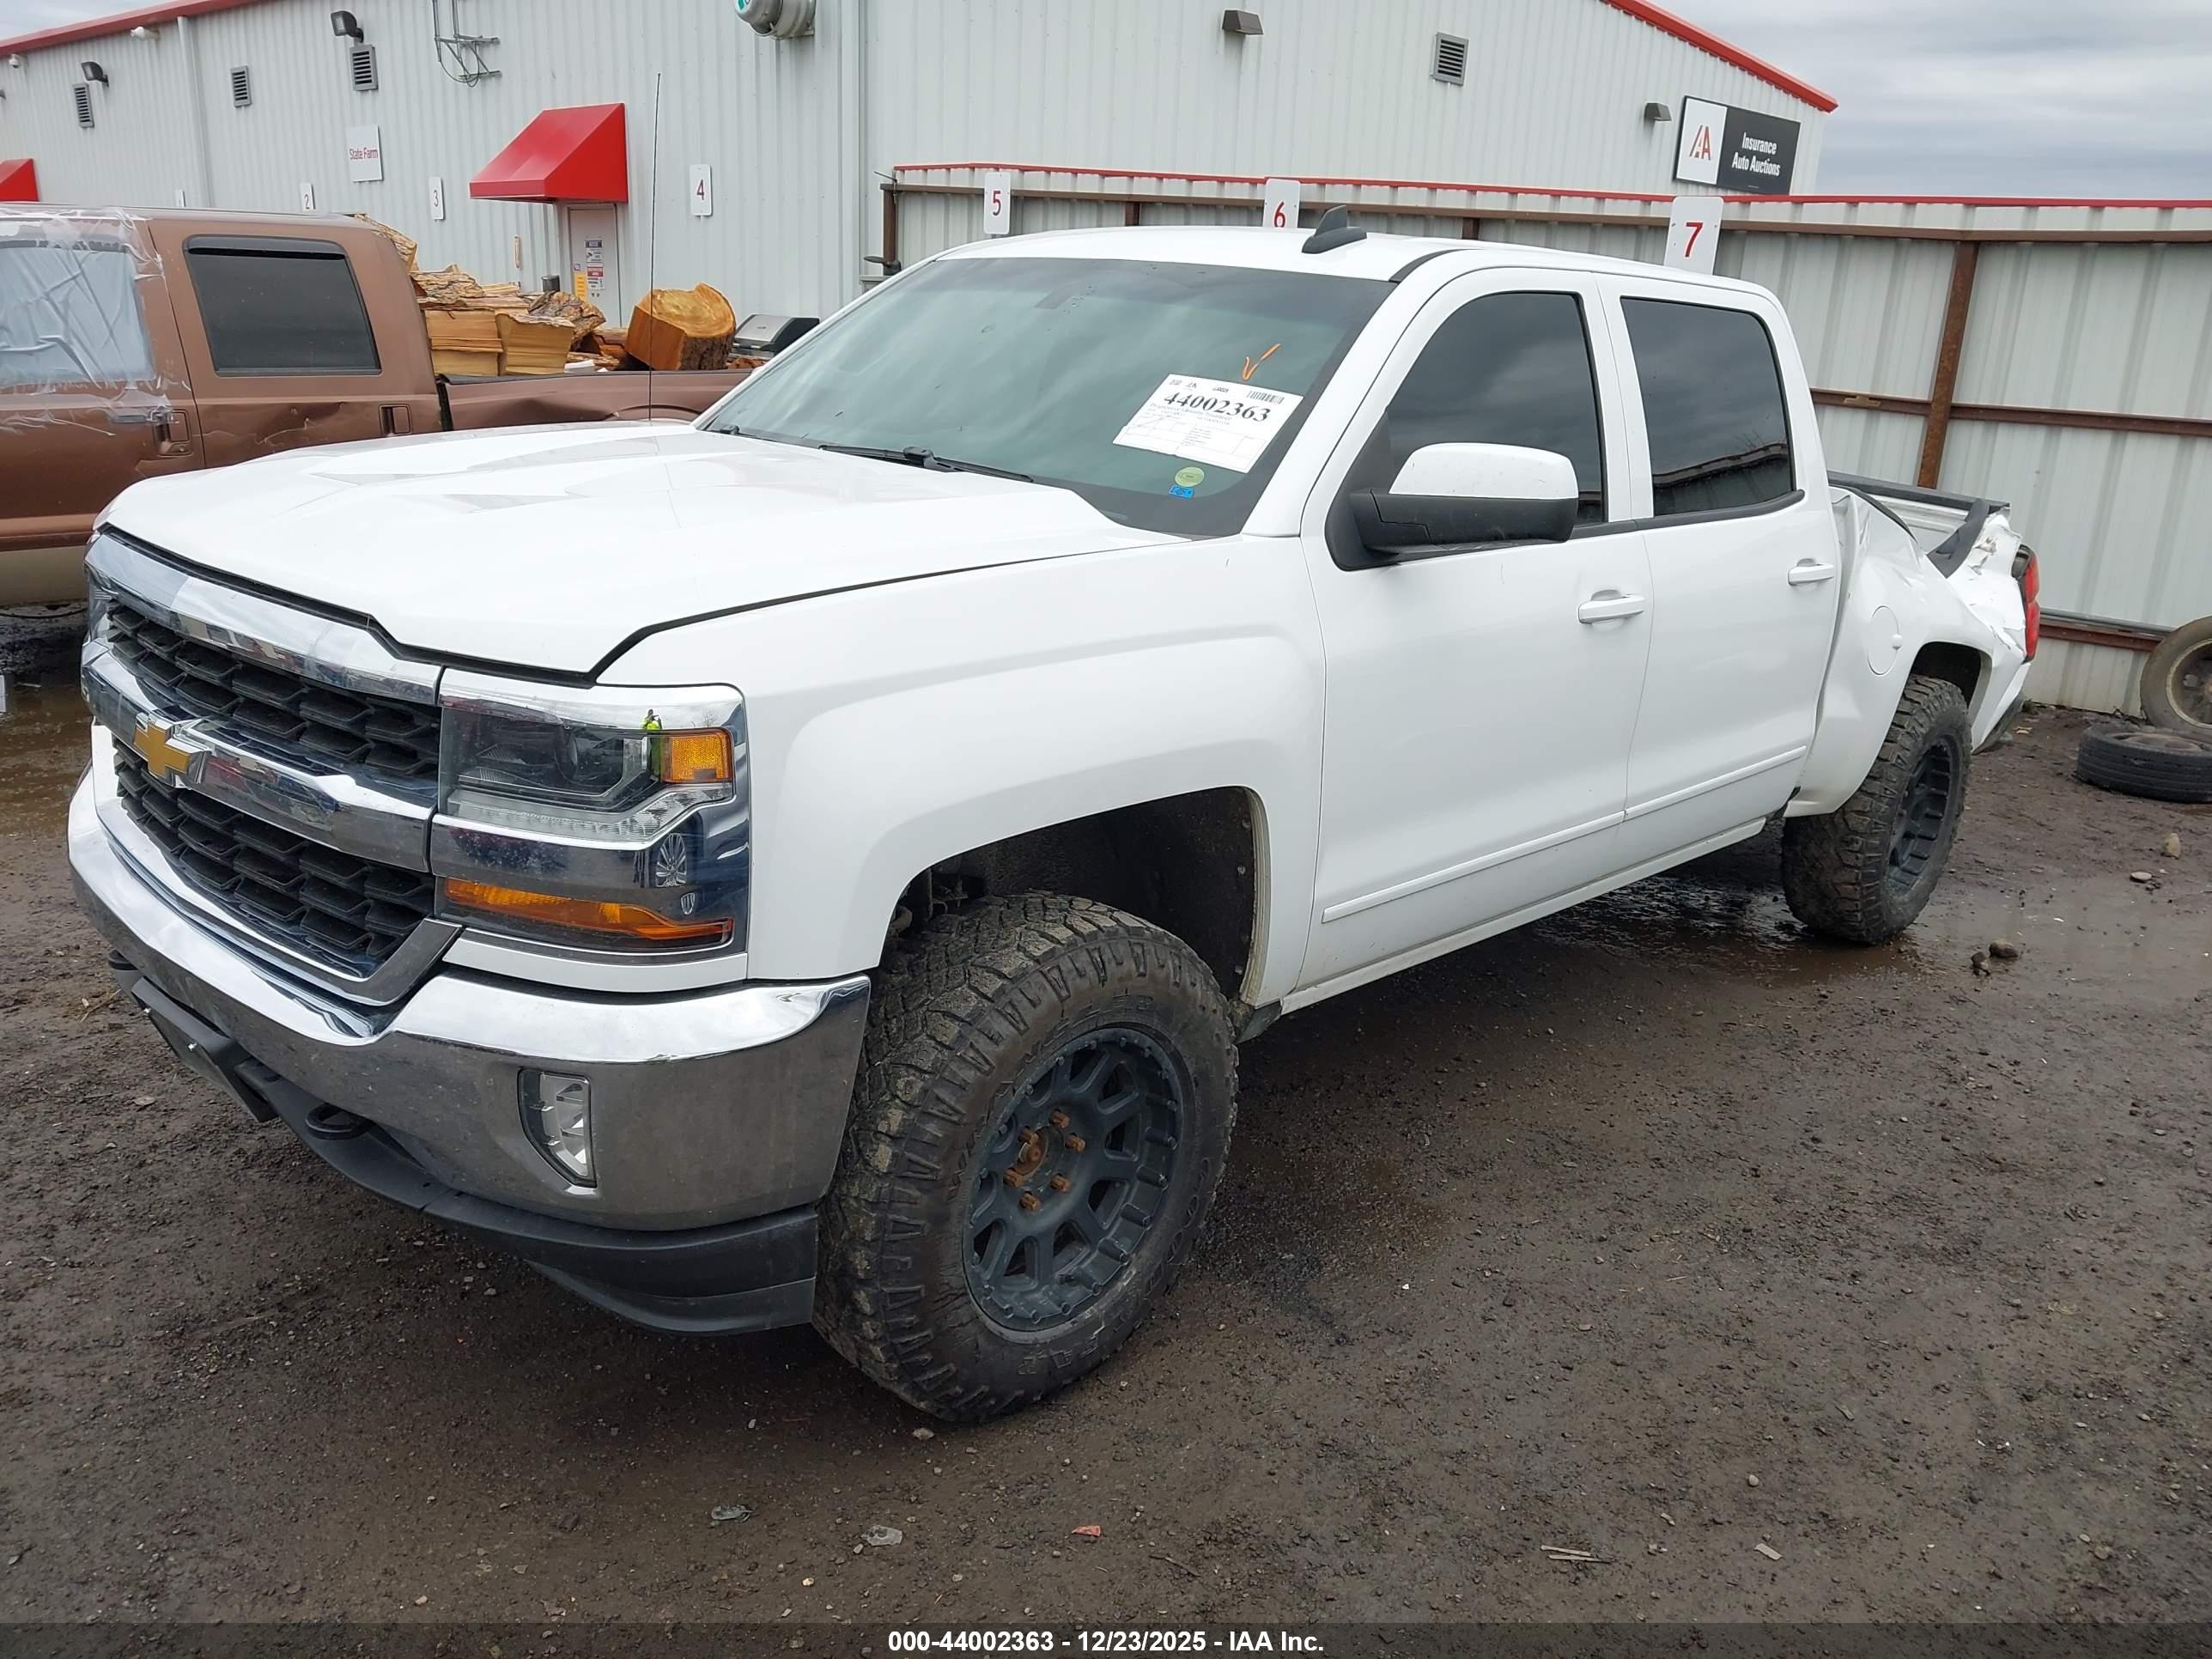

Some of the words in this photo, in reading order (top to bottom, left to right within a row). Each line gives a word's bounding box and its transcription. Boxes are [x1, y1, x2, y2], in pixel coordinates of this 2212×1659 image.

[349, 149, 363, 160] State
[363, 147, 379, 159] Farm
[1741, 131, 1778, 155] Insurance
[1732, 151, 1749, 171] Auto
[1750, 155, 1781, 177] Auctions
[304, 193, 310, 210] 2
[434, 189, 440, 207] 3
[696, 179, 705, 201] 4
[992, 190, 1001, 216] 5
[1273, 201, 1286, 228] 6
[1685, 222, 1704, 257] 7
[1164, 392, 1272, 422] 44002363
